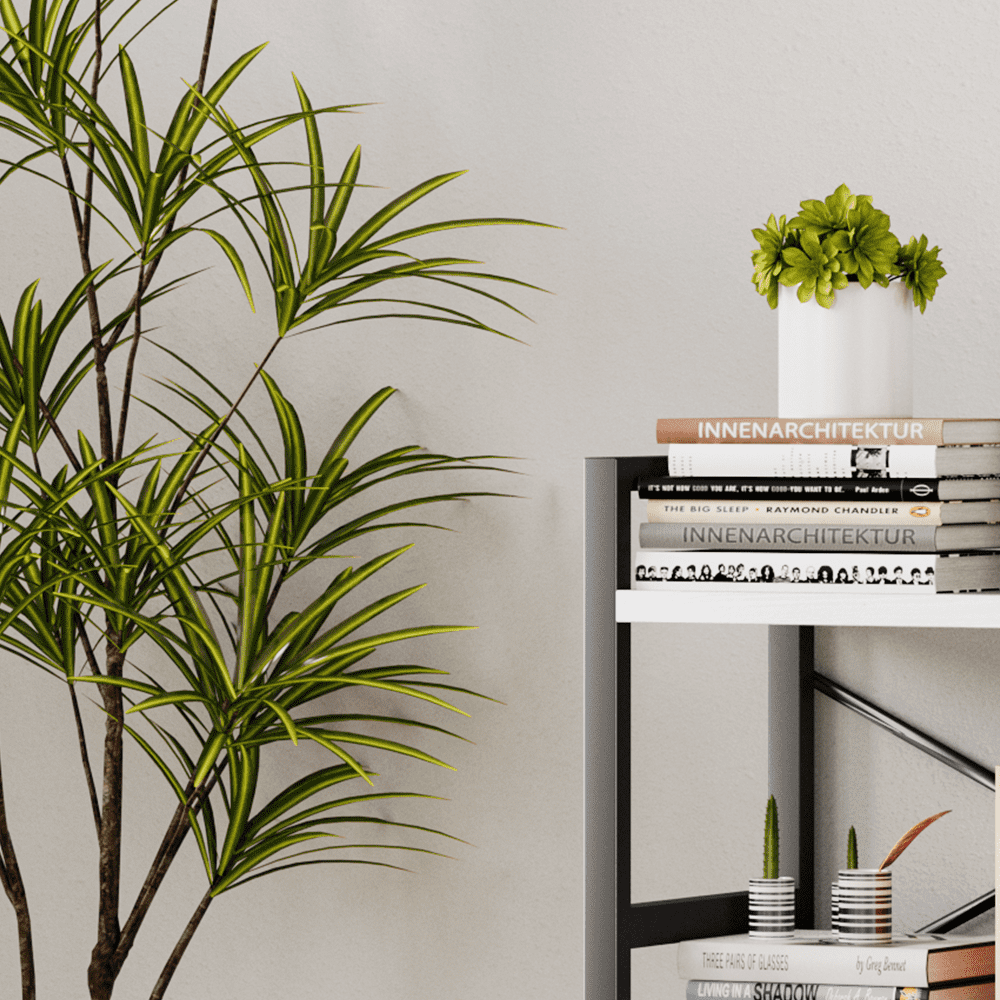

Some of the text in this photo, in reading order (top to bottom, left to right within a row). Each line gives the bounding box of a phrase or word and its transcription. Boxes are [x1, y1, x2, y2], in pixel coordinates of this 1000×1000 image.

[698, 421, 924, 440] INNENARCHITEKTUR
[716, 506, 750, 514] SLEEP
[683, 526, 916, 545] INNENARCHITEKTUR
[702, 952, 789, 972] THREE PAIRS OF GLASSES
[856, 956, 907, 976] by Greg Bennet
[697, 982, 730, 998] LIVING
[732, 983, 742, 998] IN
[744, 984, 752, 998] A
